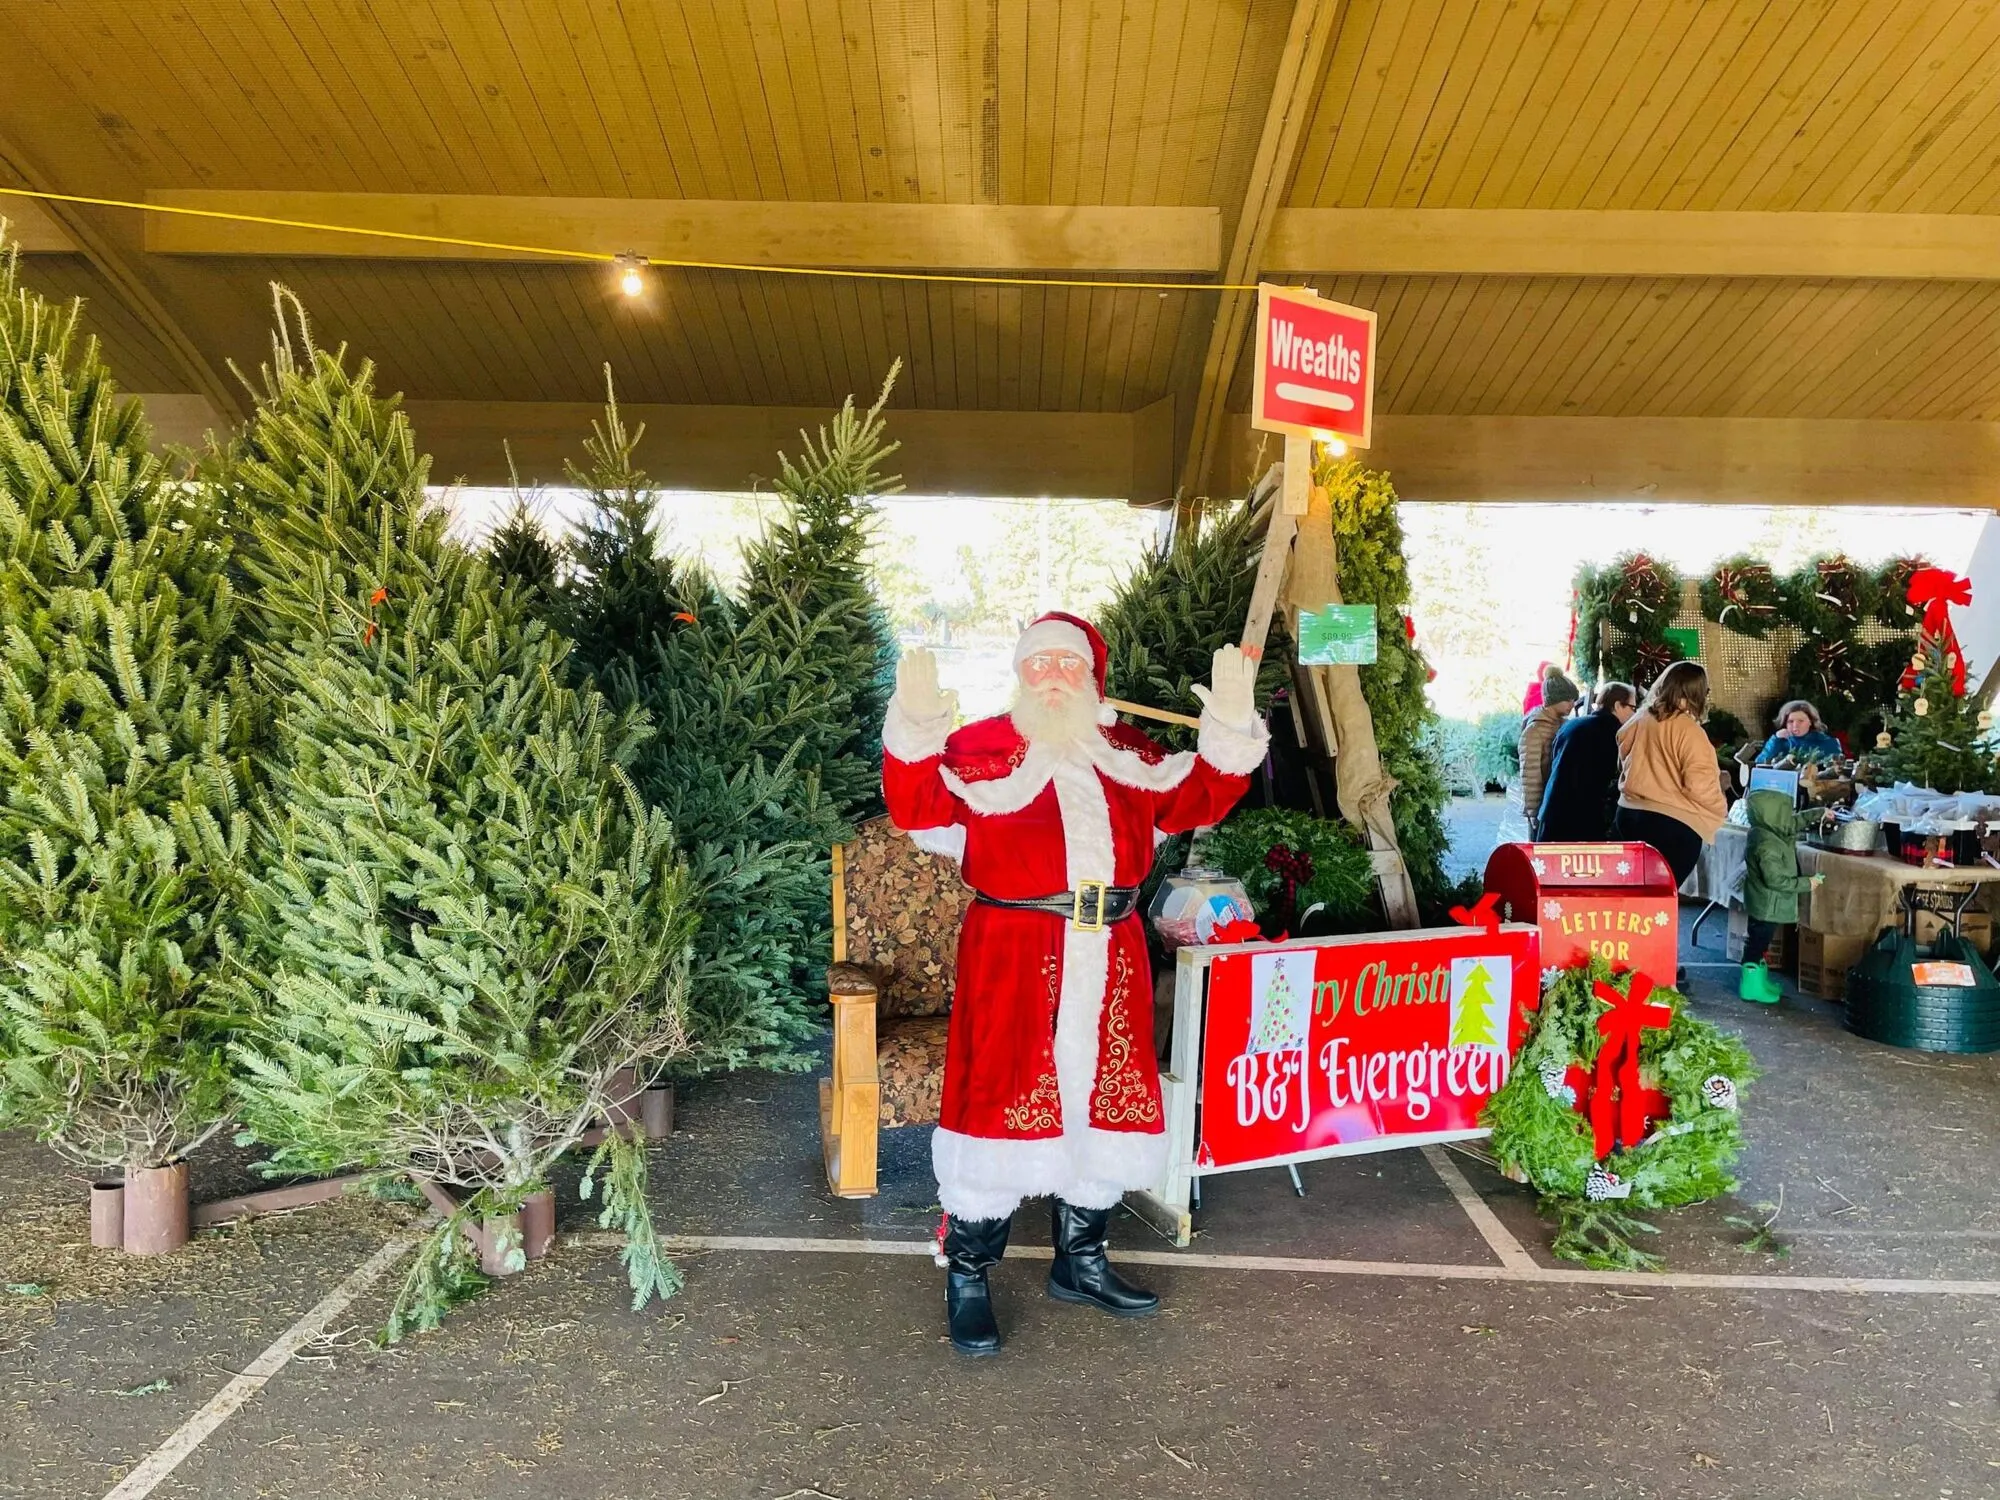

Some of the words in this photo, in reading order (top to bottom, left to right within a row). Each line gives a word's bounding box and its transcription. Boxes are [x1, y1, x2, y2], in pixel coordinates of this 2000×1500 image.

[1271, 318, 1361, 384] Wreaths
[1561, 855, 1604, 874] PULL
[1560, 911, 1653, 936] LETTERS
[1590, 940, 1630, 961] FOR
[1227, 1048, 1310, 1133] B&J
[1319, 1038, 1511, 1120] Evergreen
